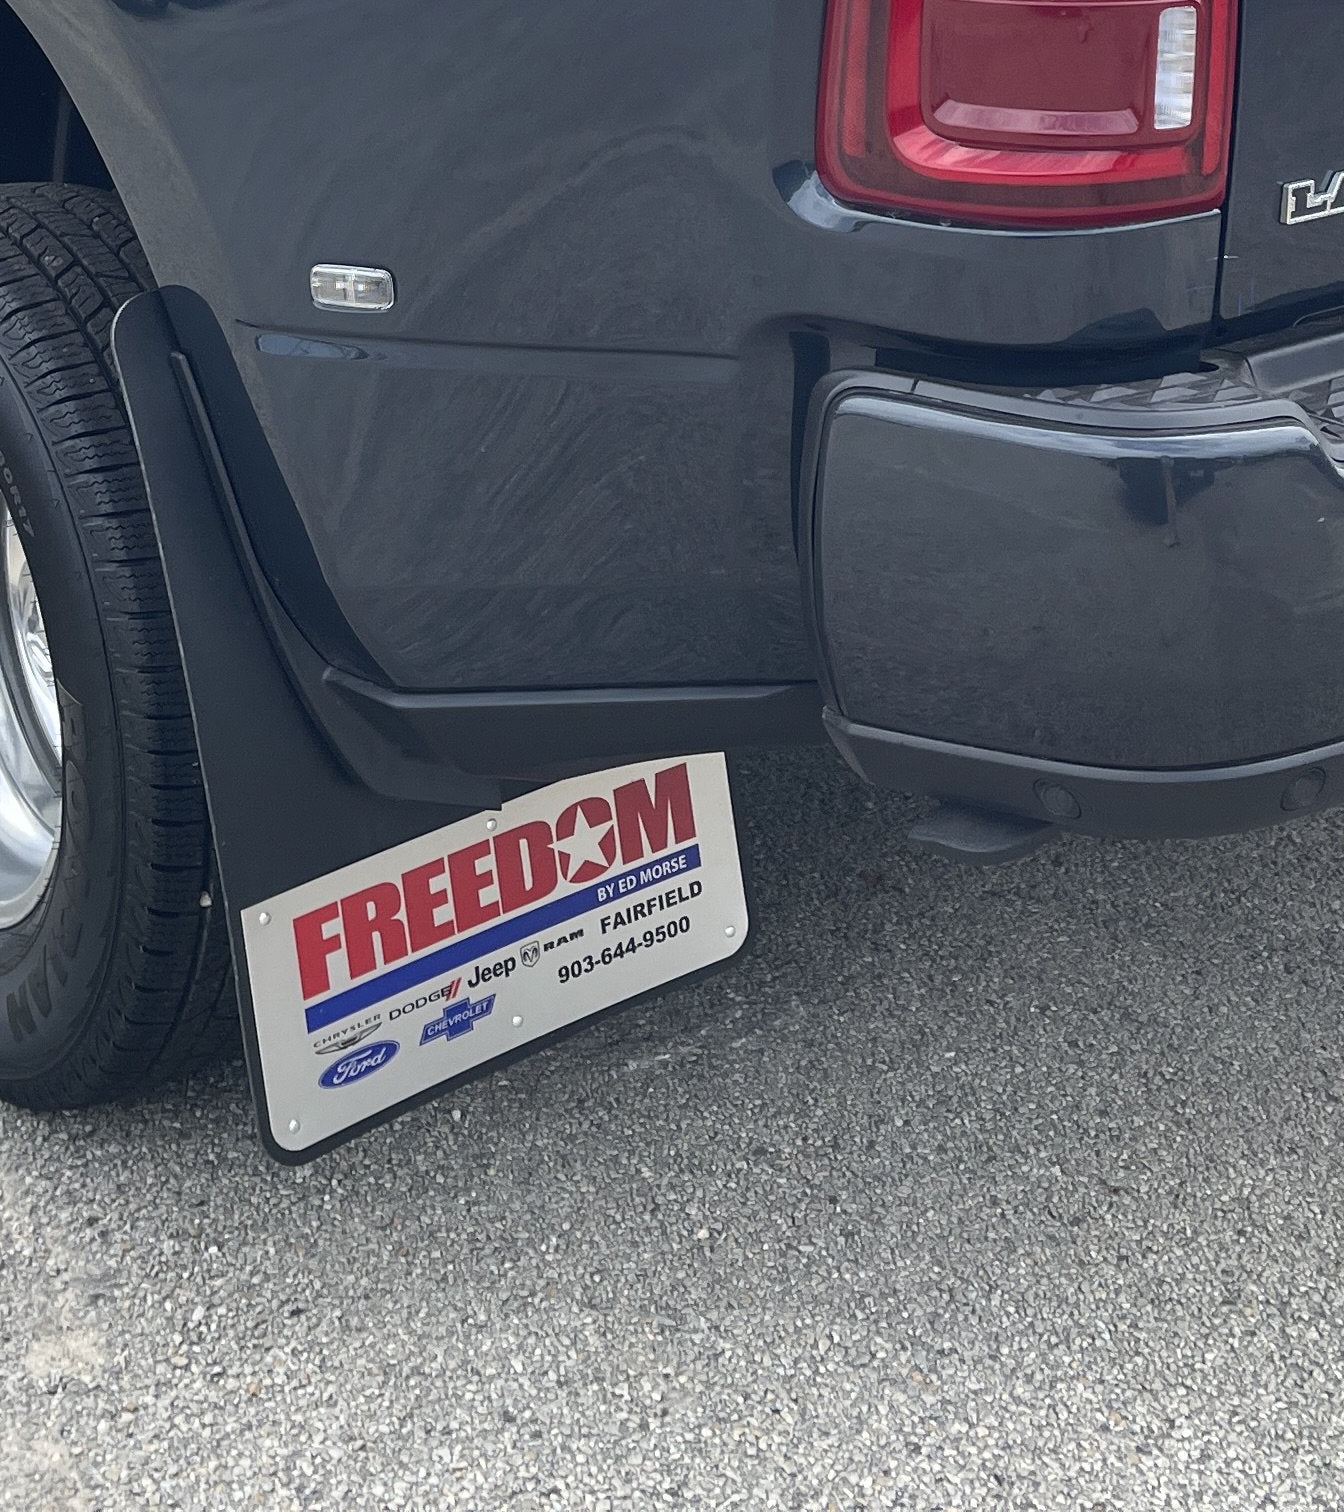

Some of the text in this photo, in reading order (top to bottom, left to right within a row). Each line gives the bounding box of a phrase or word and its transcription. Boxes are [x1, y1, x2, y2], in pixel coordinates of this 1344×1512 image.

[292, 762, 697, 1000] FREEDOM
[596, 855, 687, 902] BY ED MORSE
[313, 879, 703, 1048] CHRYSLER DODGE Jeep RAM FAIRFIELD
[557, 916, 691, 985] 903-644-9500
[332, 1001, 489, 1086] Ford CHEVROLET
